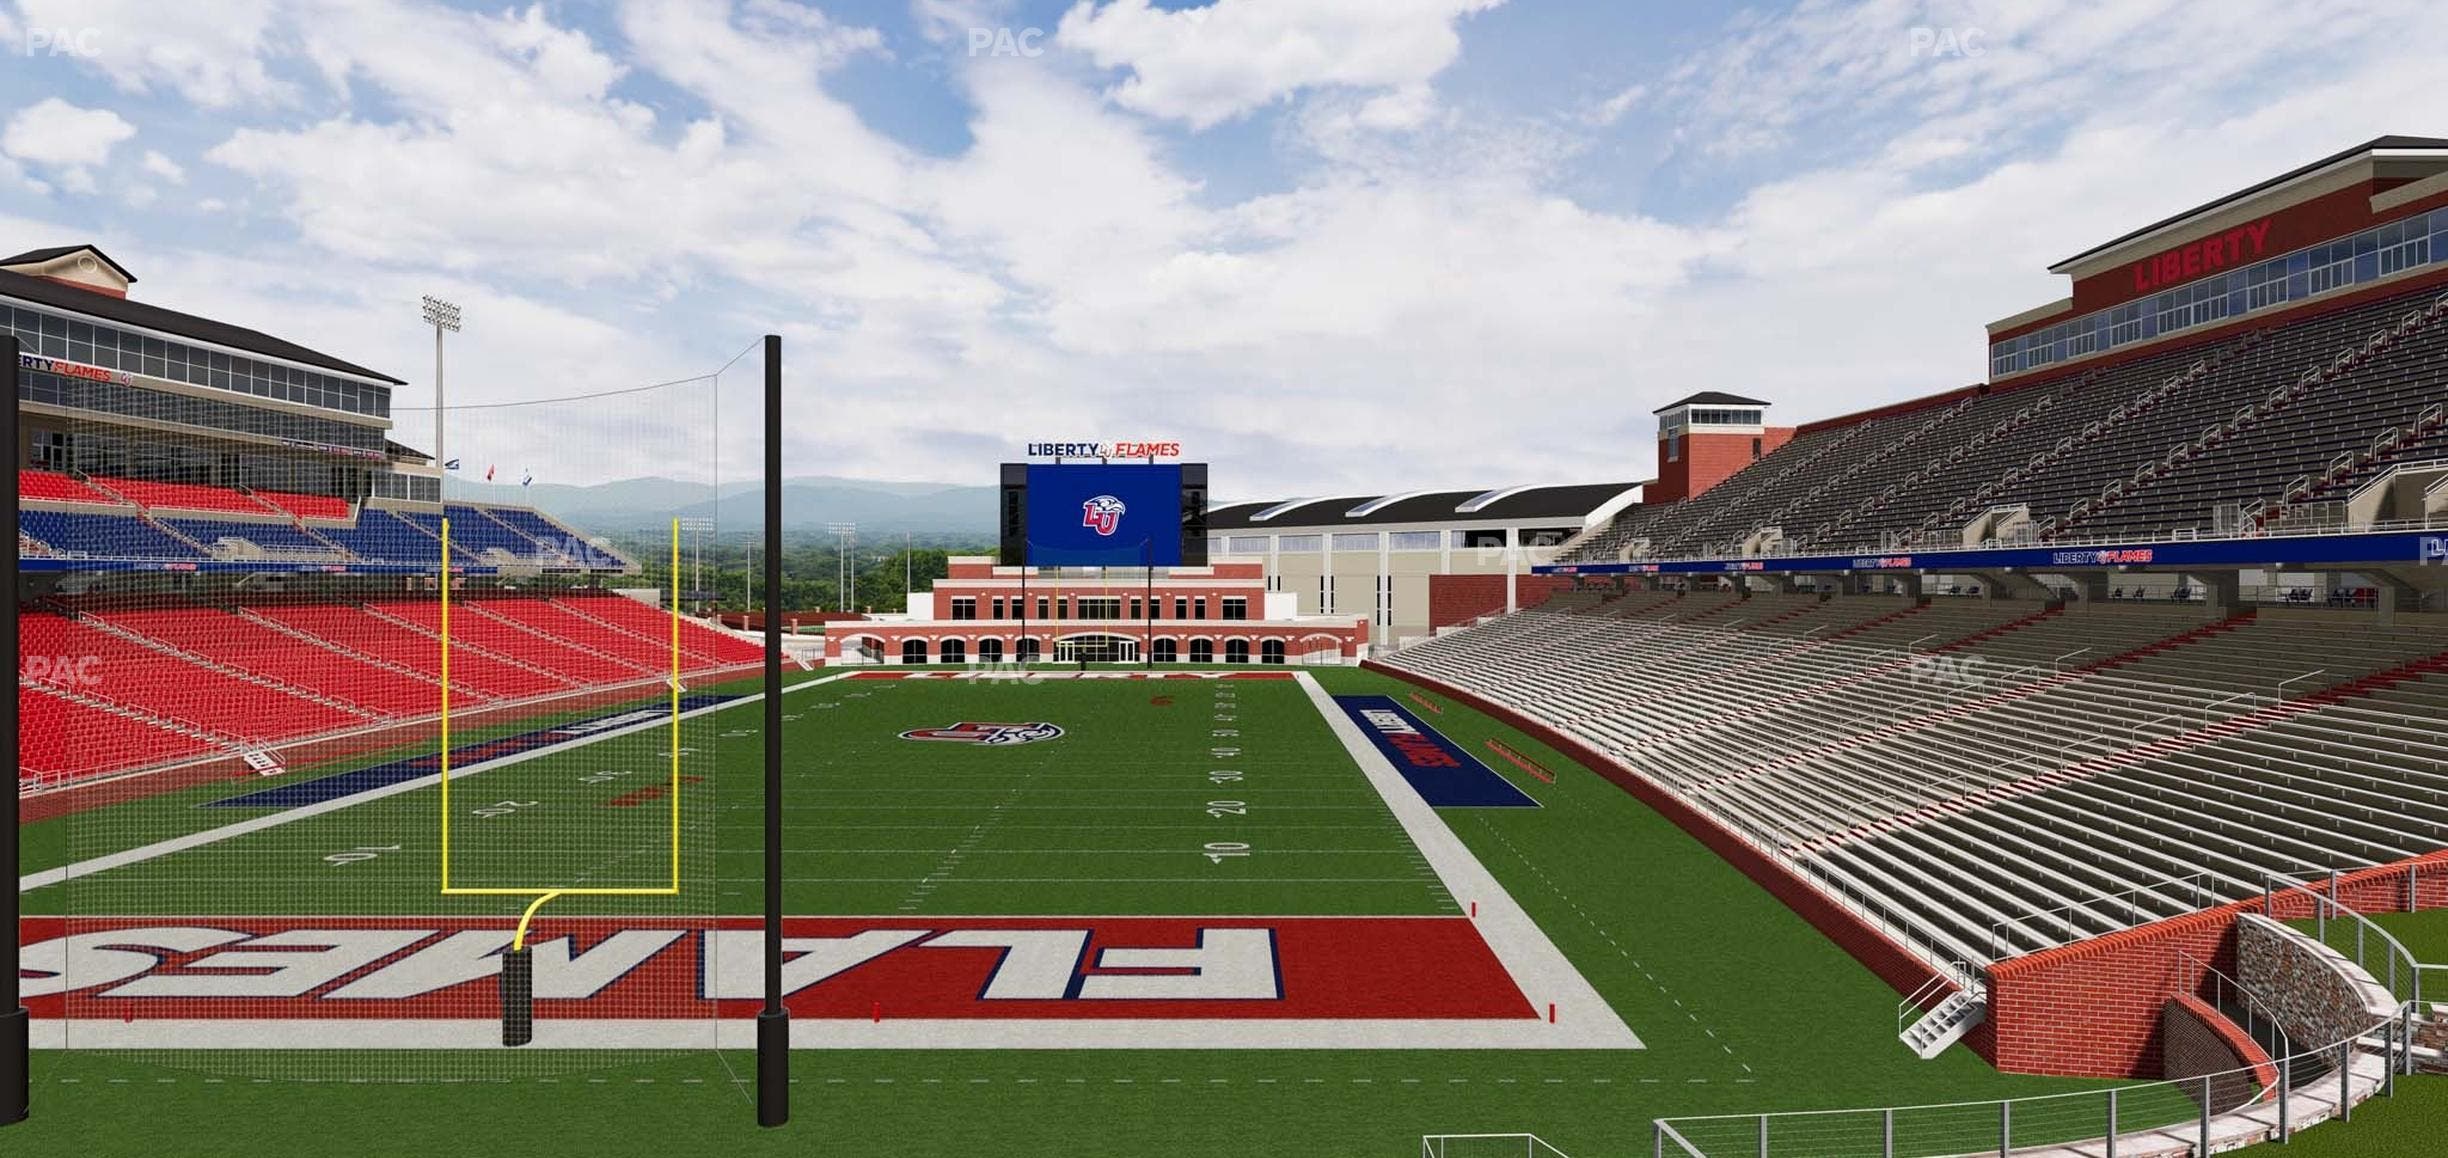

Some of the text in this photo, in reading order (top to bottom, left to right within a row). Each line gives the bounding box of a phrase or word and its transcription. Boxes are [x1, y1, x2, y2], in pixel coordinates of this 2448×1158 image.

[2133, 218, 2273, 292] LIBERTY
[53, 361, 112, 382] FLAMES
[1028, 443, 1099, 456] LIBERTY
[1115, 442, 1180, 457] FLAMES
[2053, 551, 2098, 564] LIBERTY
[1206, 800, 1246, 815] 20
[1202, 842, 1251, 858] 10
[19, 926, 1285, 1000] FLAMES
